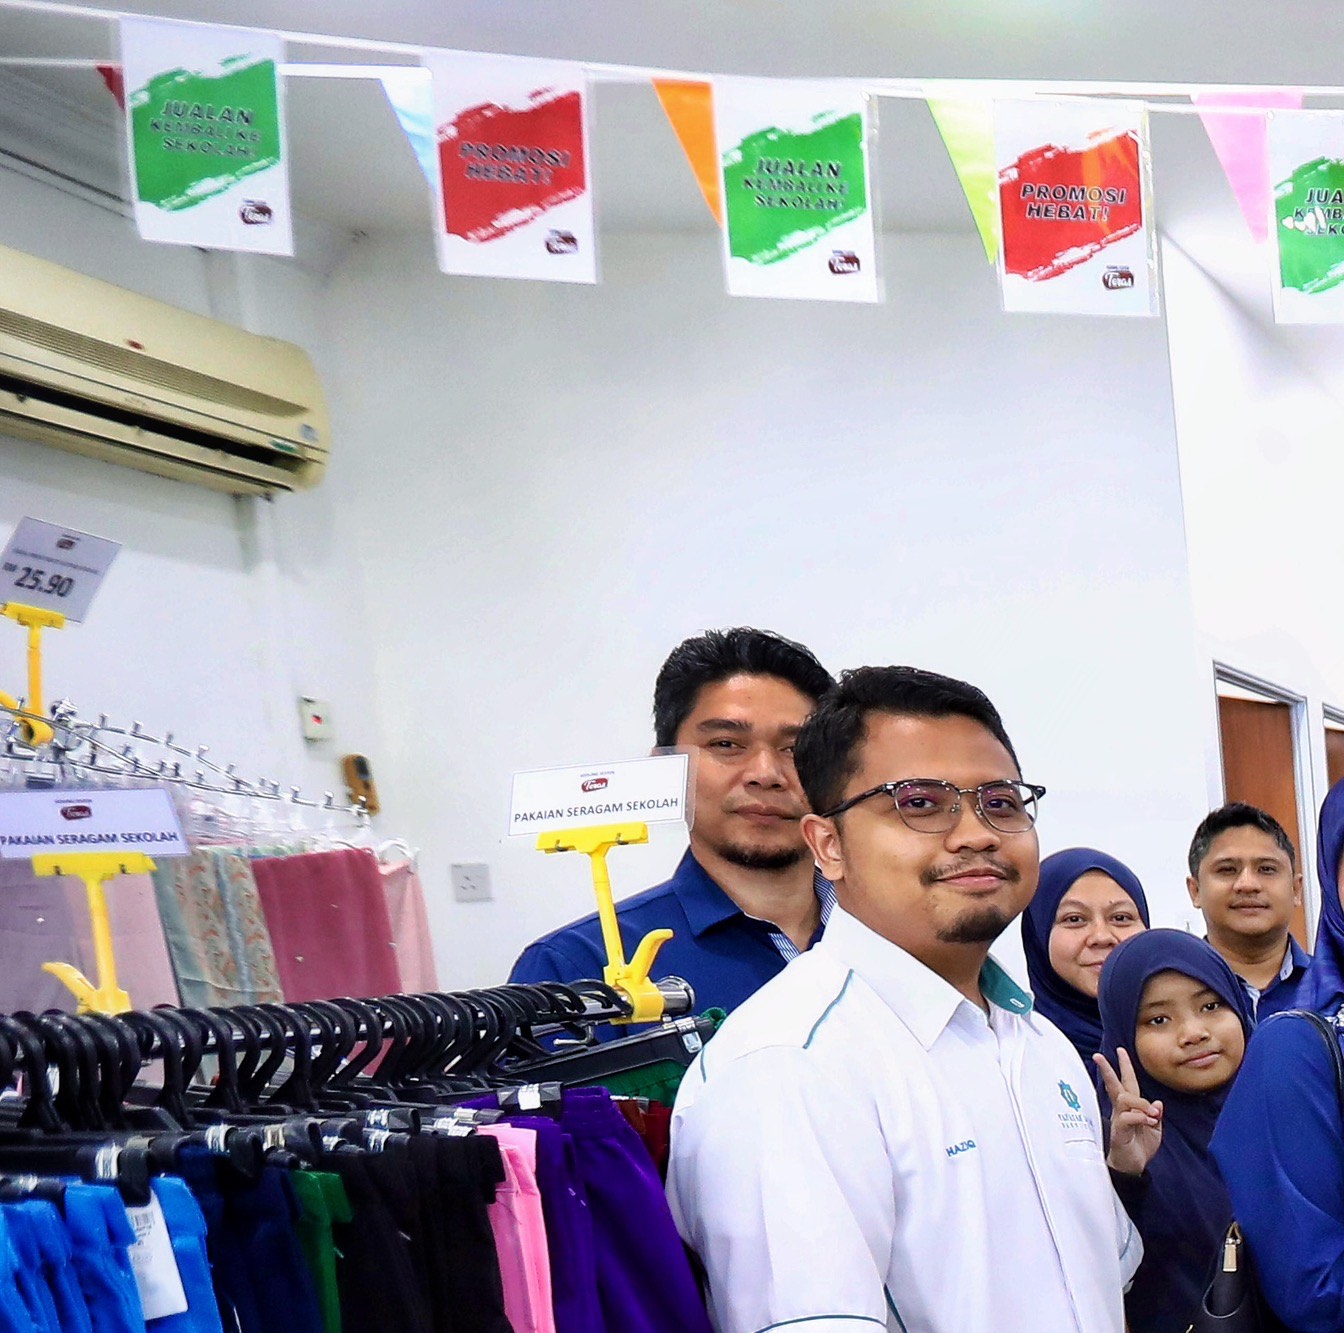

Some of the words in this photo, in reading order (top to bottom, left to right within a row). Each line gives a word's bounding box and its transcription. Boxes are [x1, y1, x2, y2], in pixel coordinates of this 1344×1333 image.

[1020, 183, 1128, 205] PROMOSI
[1025, 202, 1110, 223] HEBAT!
[14, 566, 75, 598] 25.90
[514, 808, 563, 823] PAKAIAN
[567, 803, 623, 817] SERAGAM
[626, 798, 679, 811] SEKOLAH
[0, 835, 55, 846] PAKAIAN
[57, 833, 119, 845] SERAGAM
[121, 832, 179, 844] SEKOLAH
